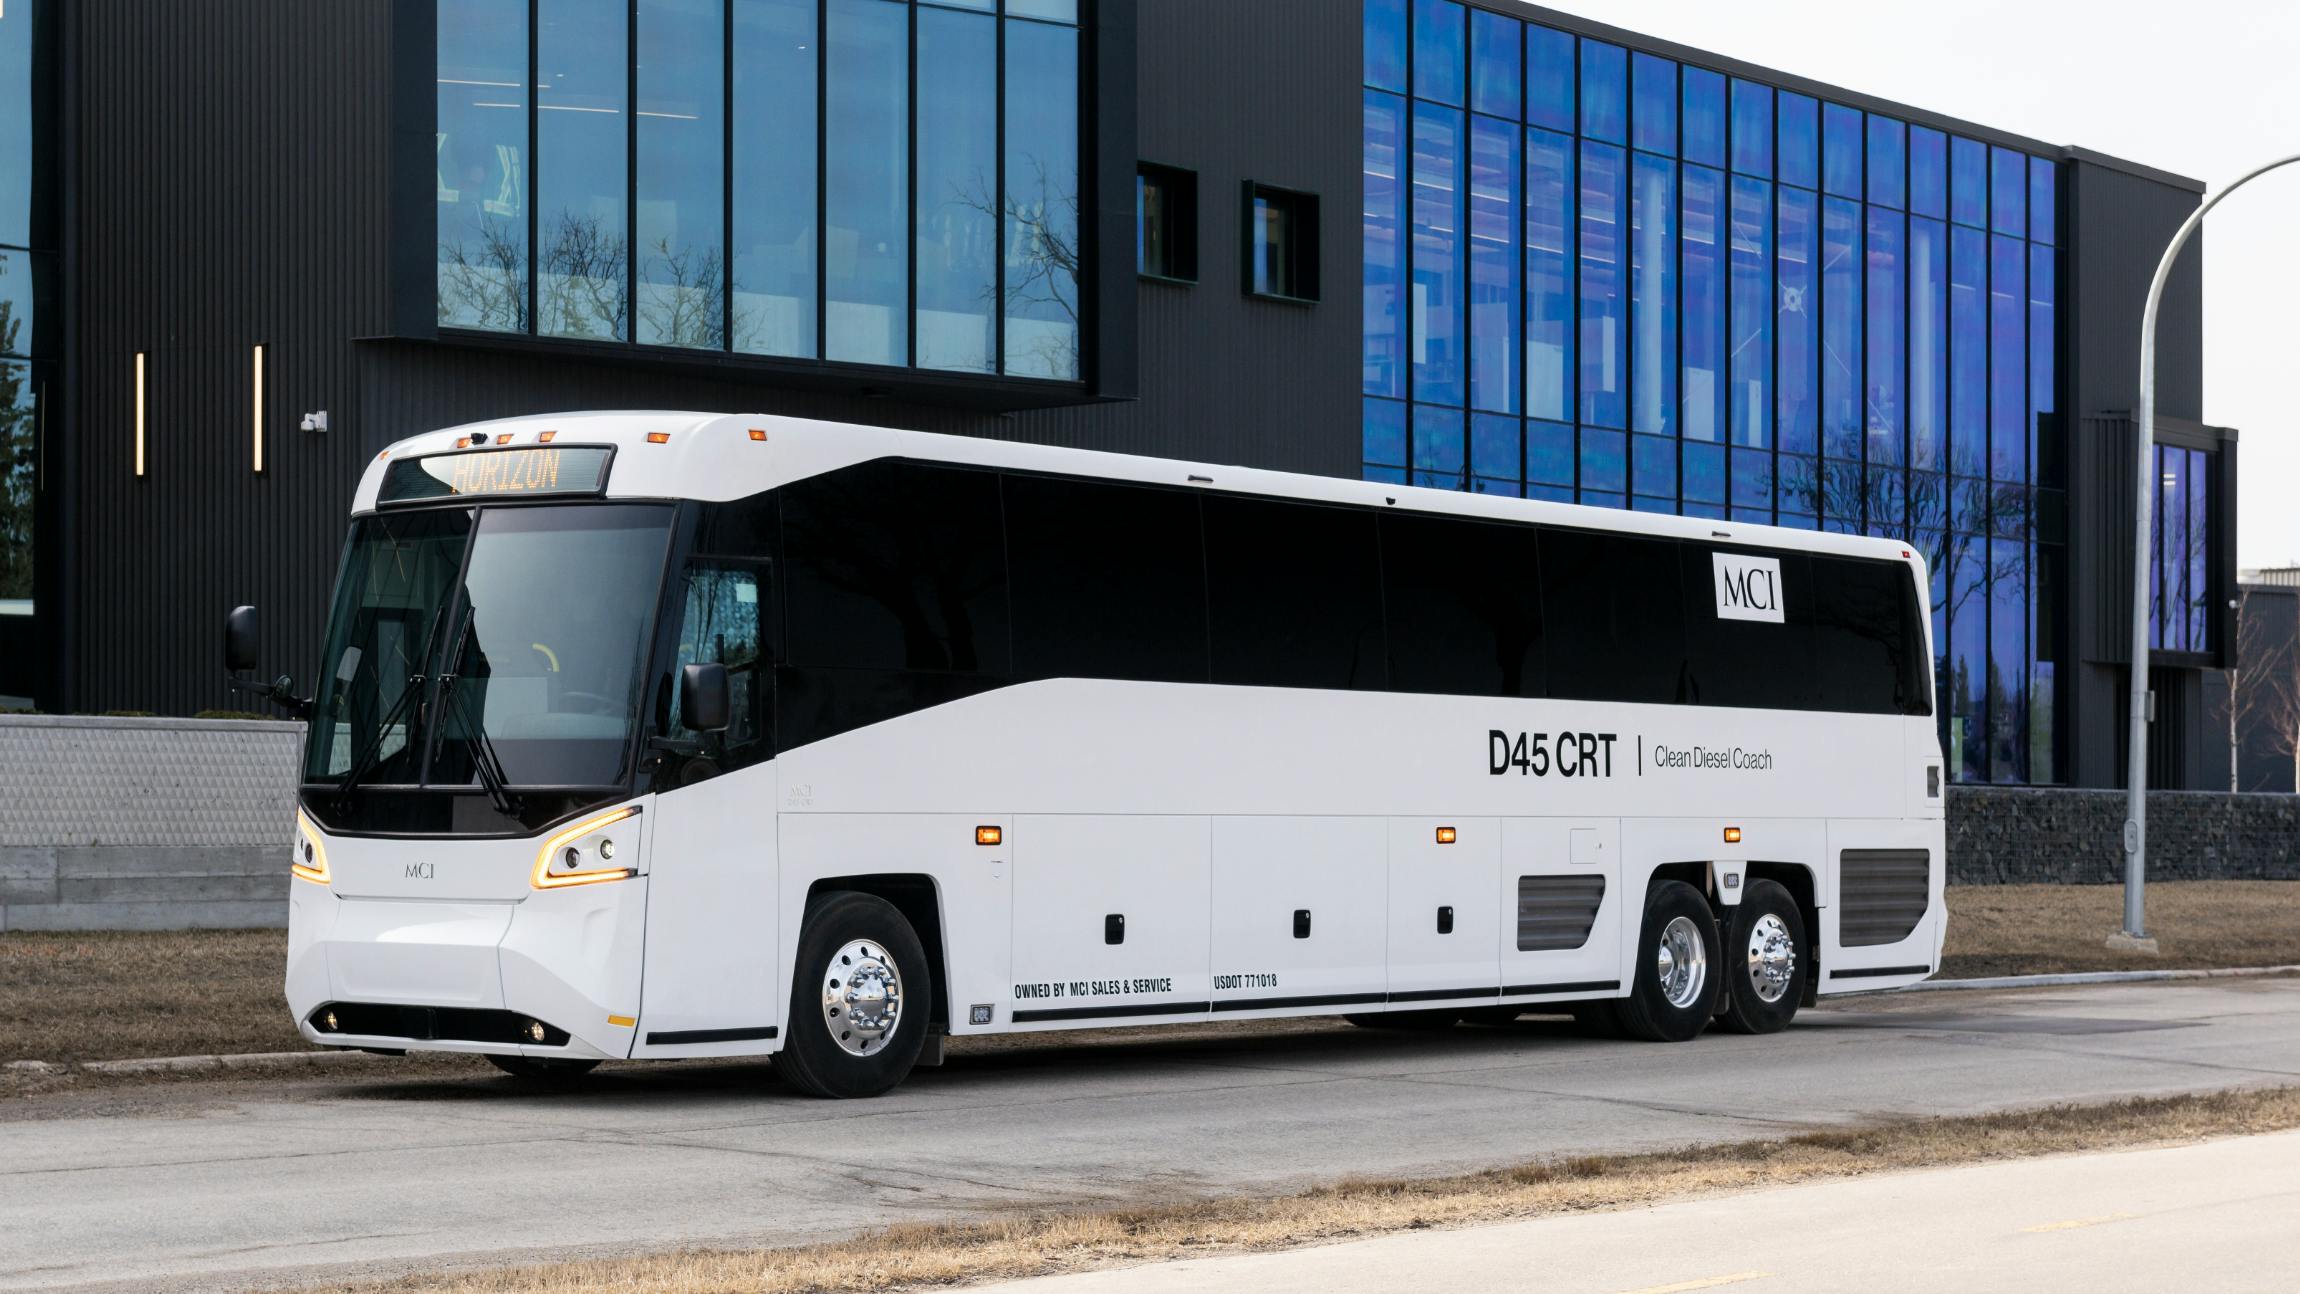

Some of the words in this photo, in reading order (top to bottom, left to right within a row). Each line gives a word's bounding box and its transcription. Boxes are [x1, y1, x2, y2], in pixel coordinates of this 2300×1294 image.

[451, 448, 560, 495] HORIZON
[1723, 565, 1777, 611] MCI
[1489, 730, 1550, 777] D45
[1556, 731, 1617, 777] CRT
[1655, 745, 1691, 768] Clean
[1694, 746, 1730, 769] Diesel
[1733, 747, 1772, 770] Coach
[405, 862, 434, 879] MCI
[1014, 983, 1050, 999] OWNED
[1053, 982, 1065, 997] BY
[1070, 981, 1089, 997] MCI
[1092, 980, 1120, 996] SALES
[1123, 979, 1131, 994] &
[1133, 978, 1172, 993] SERVICE
[1214, 974, 1242, 990] USDOT
[1244, 973, 1277, 988] 771018
